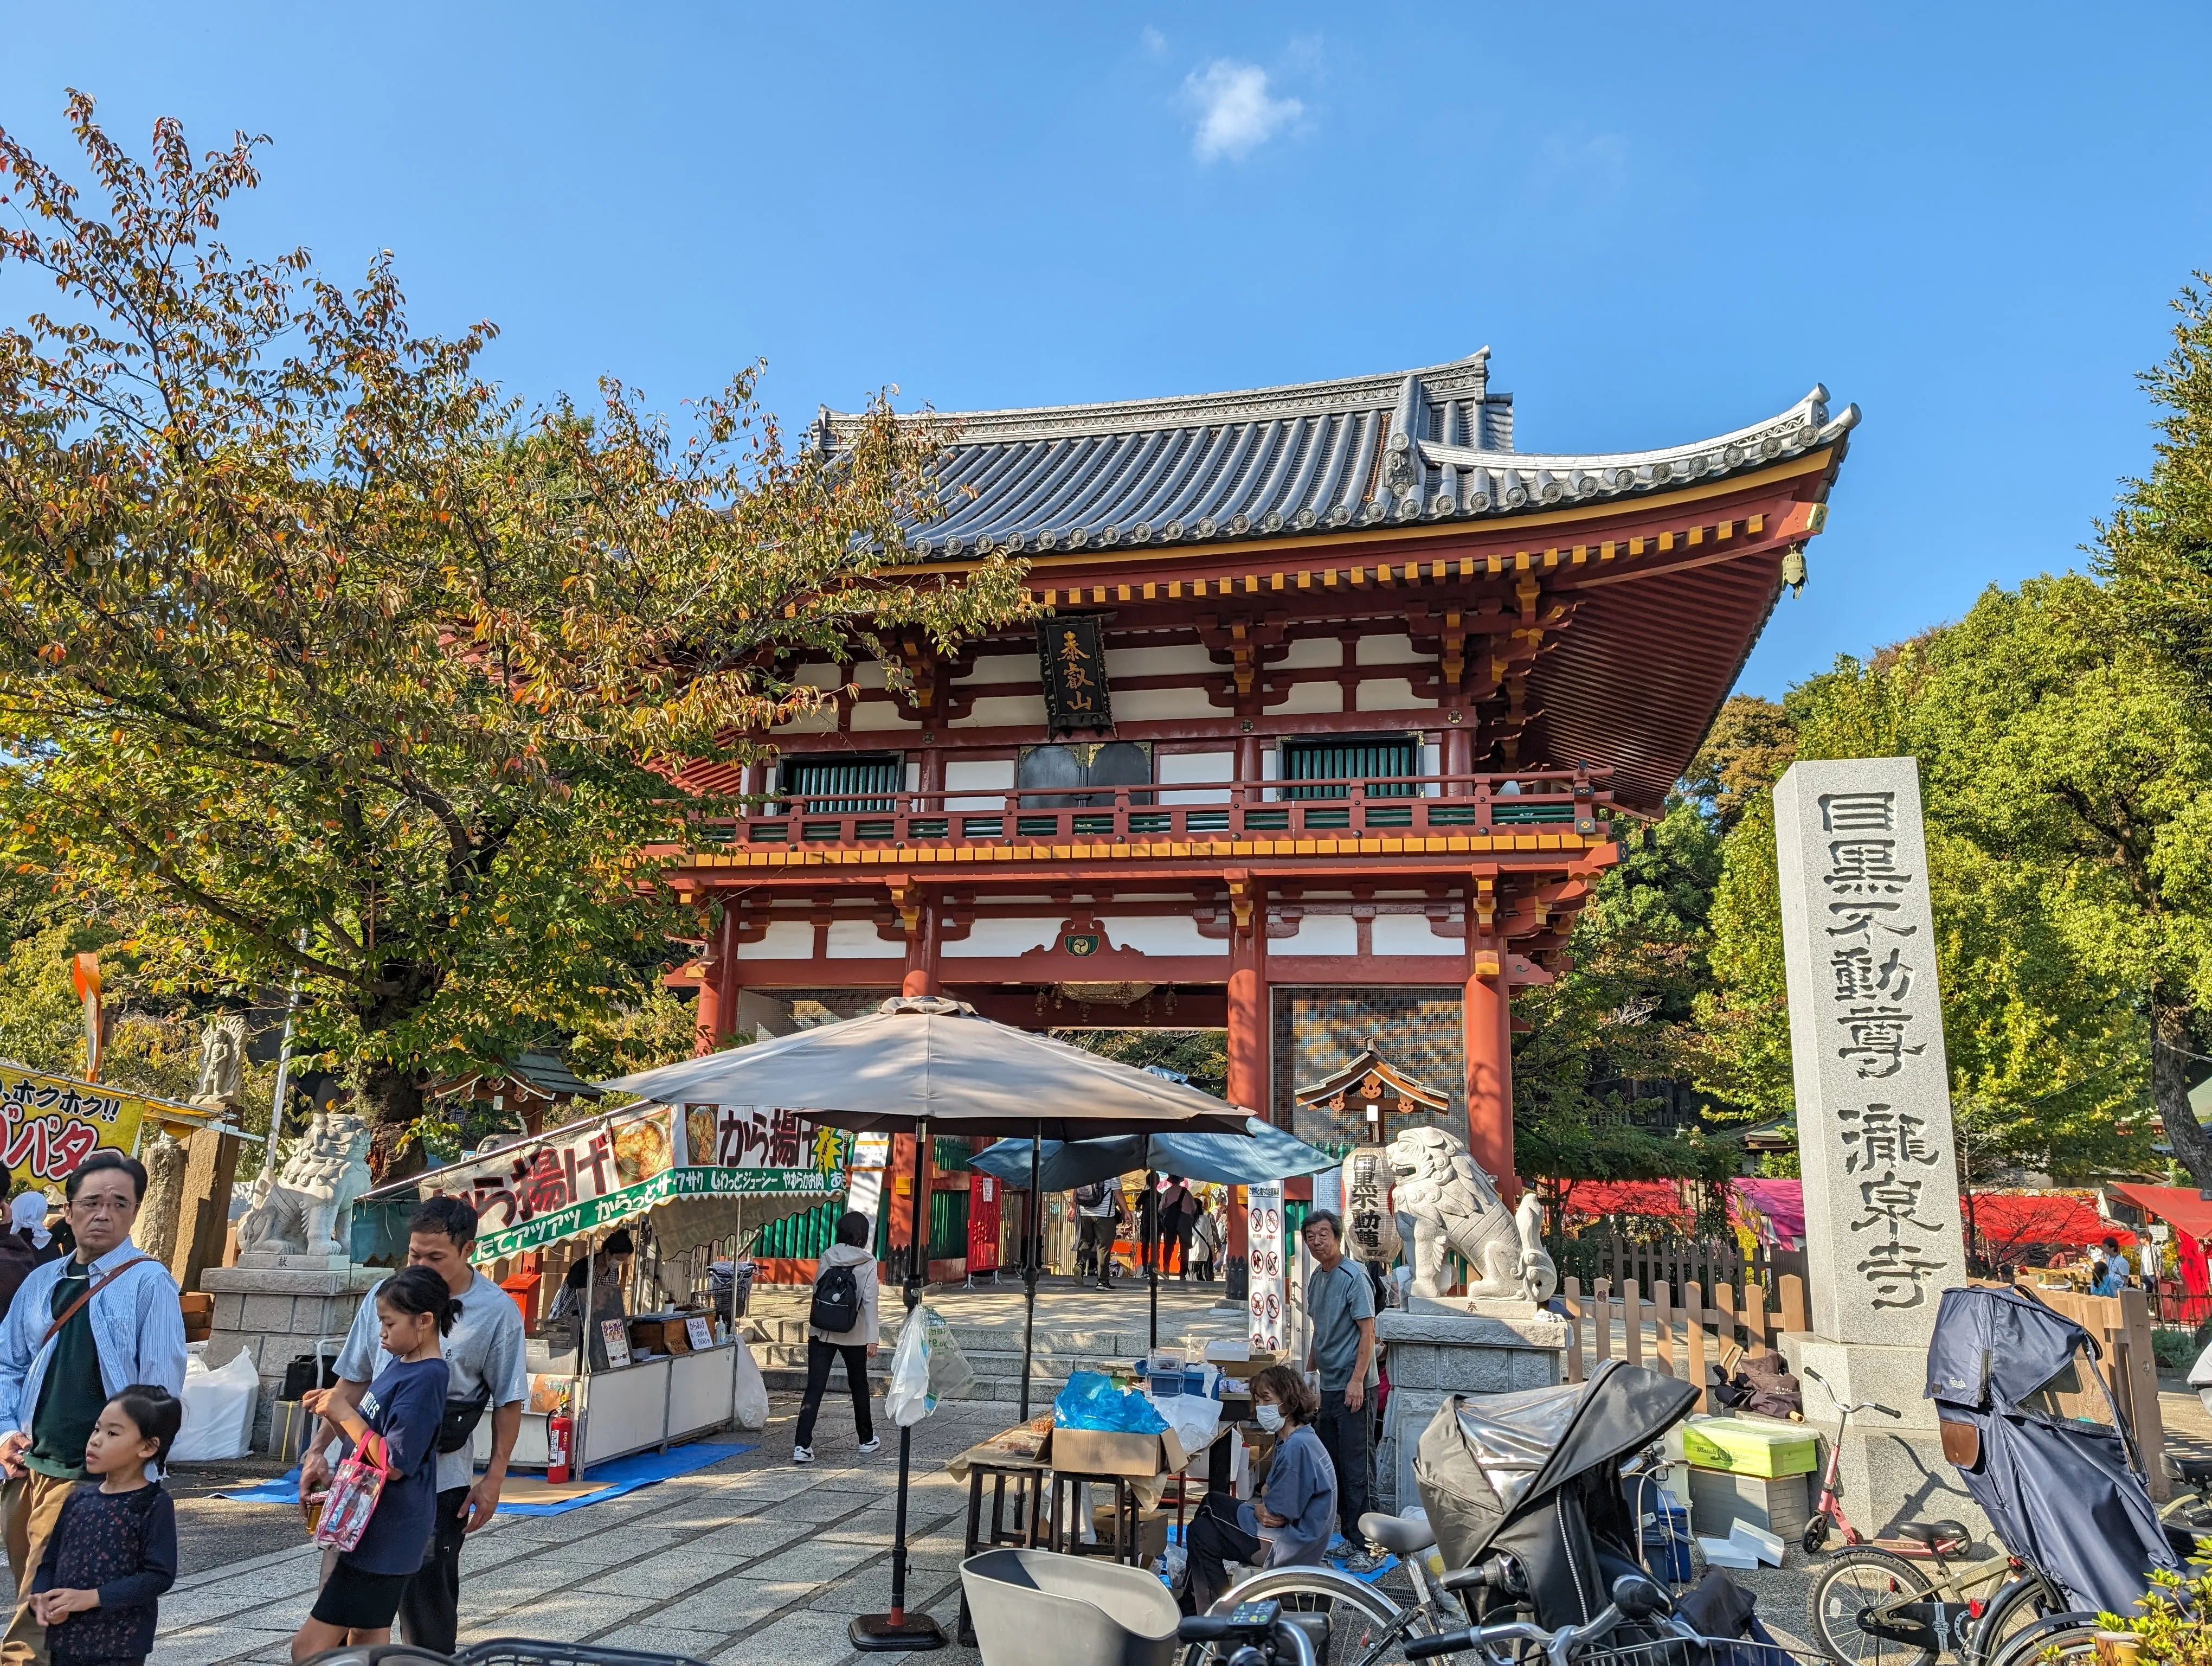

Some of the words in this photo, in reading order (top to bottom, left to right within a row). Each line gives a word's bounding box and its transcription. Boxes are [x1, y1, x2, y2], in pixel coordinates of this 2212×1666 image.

[1057, 631, 1095, 710] 泰叡山
[0, 1078, 120, 1122] 、ホクホク!!
[719, 1108, 819, 1168] から揚げ
[447, 1132, 610, 1228] ら揚げ
[467, 1209, 581, 1264] たてアツアツ
[278, 1256, 287, 1267] 献
[689, 1320, 704, 1330] からあげ
[1466, 1301, 1480, 1315] 奉
